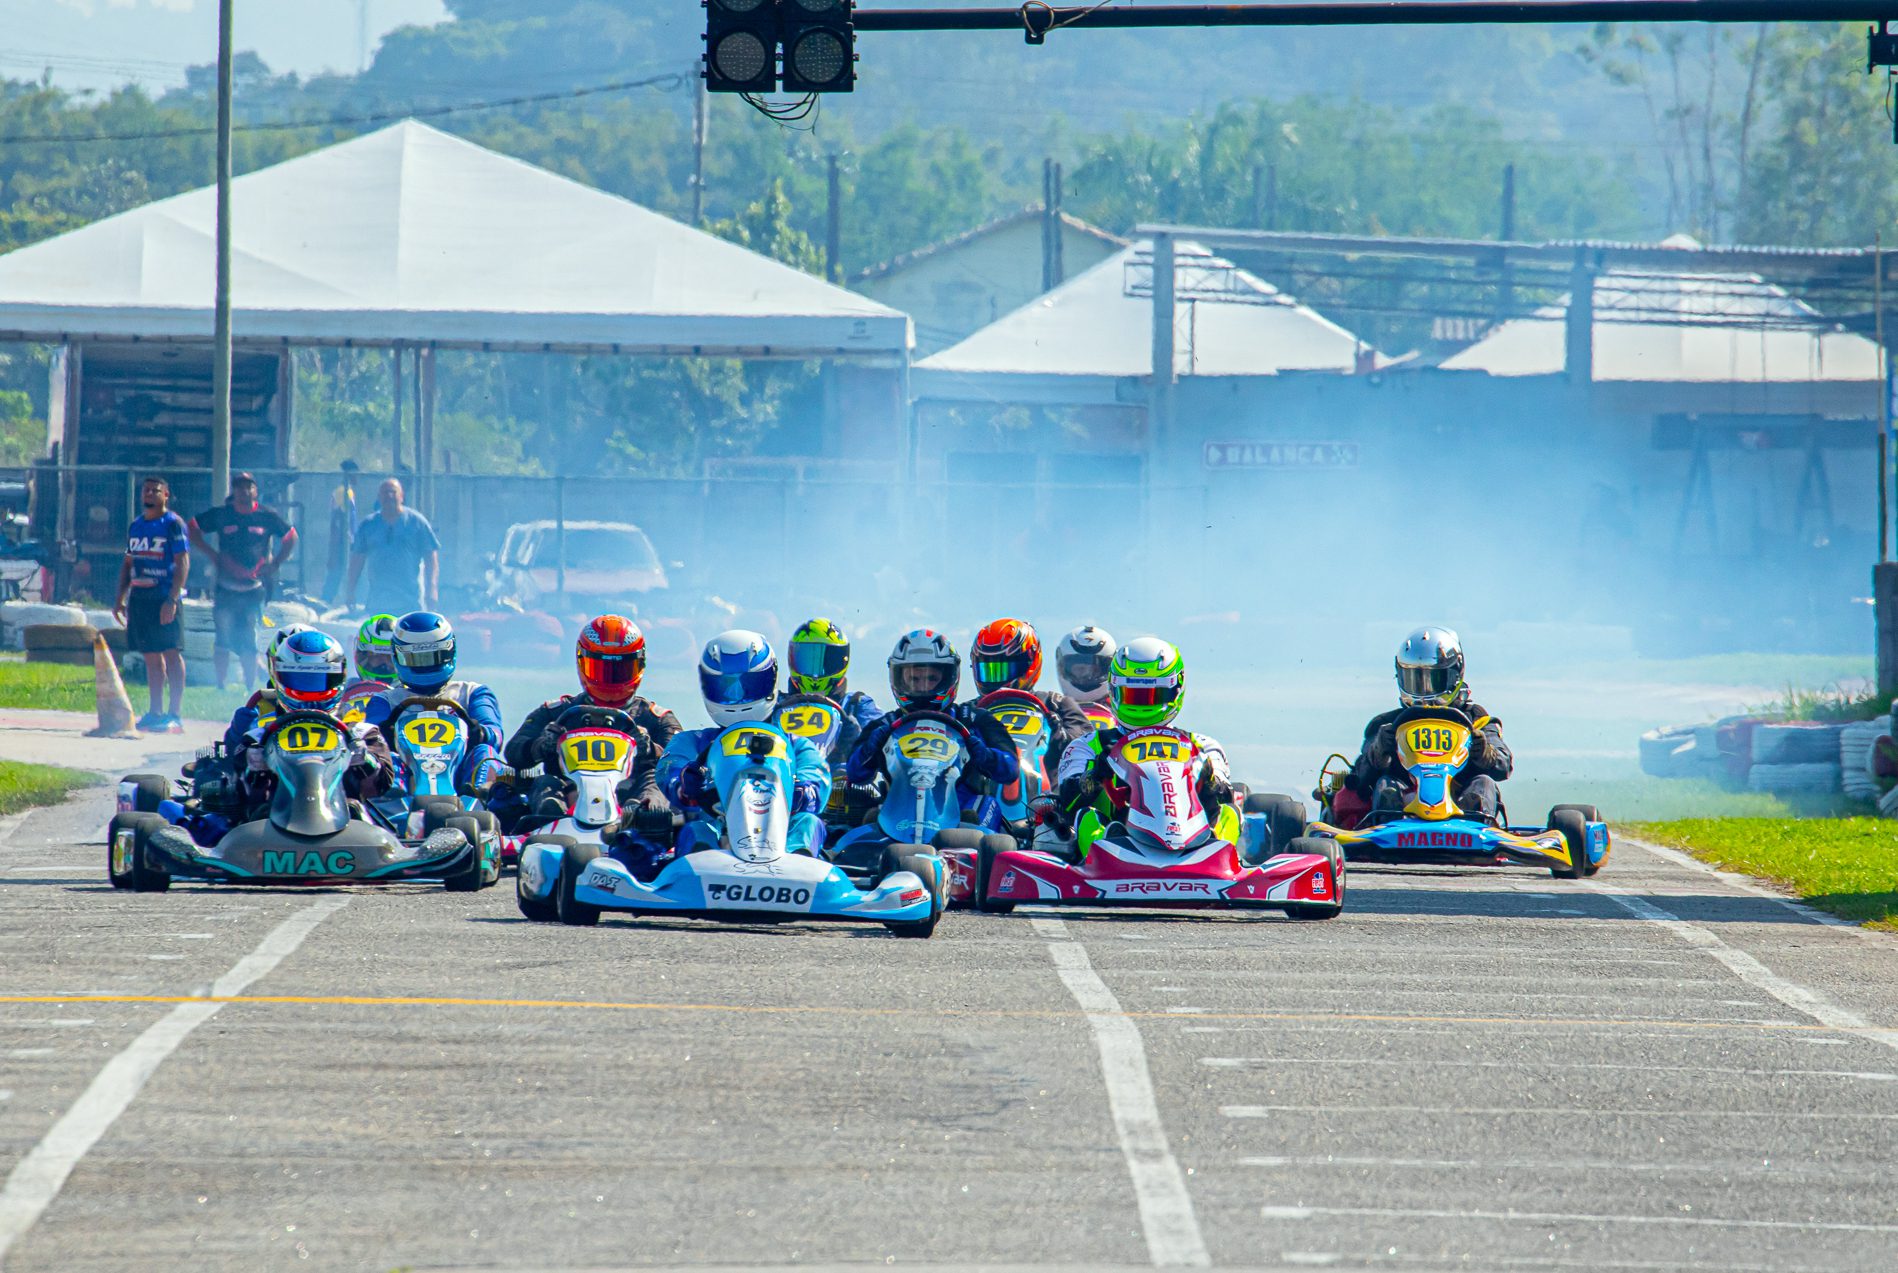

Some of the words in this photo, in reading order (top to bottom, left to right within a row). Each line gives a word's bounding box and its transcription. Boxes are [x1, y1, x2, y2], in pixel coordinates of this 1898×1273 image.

[787, 712, 824, 730] 54
[288, 727, 329, 749] 07
[412, 723, 448, 744] 12
[1412, 728, 1453, 751] 1313
[570, 739, 616, 762] 10
[908, 737, 949, 756] 29
[1131, 742, 1180, 761] 747
[1397, 832, 1473, 847] MAGNO
[262, 849, 356, 876] MAC
[726, 884, 810, 905] GLOBO
[1115, 881, 1212, 895] BRAVAR
